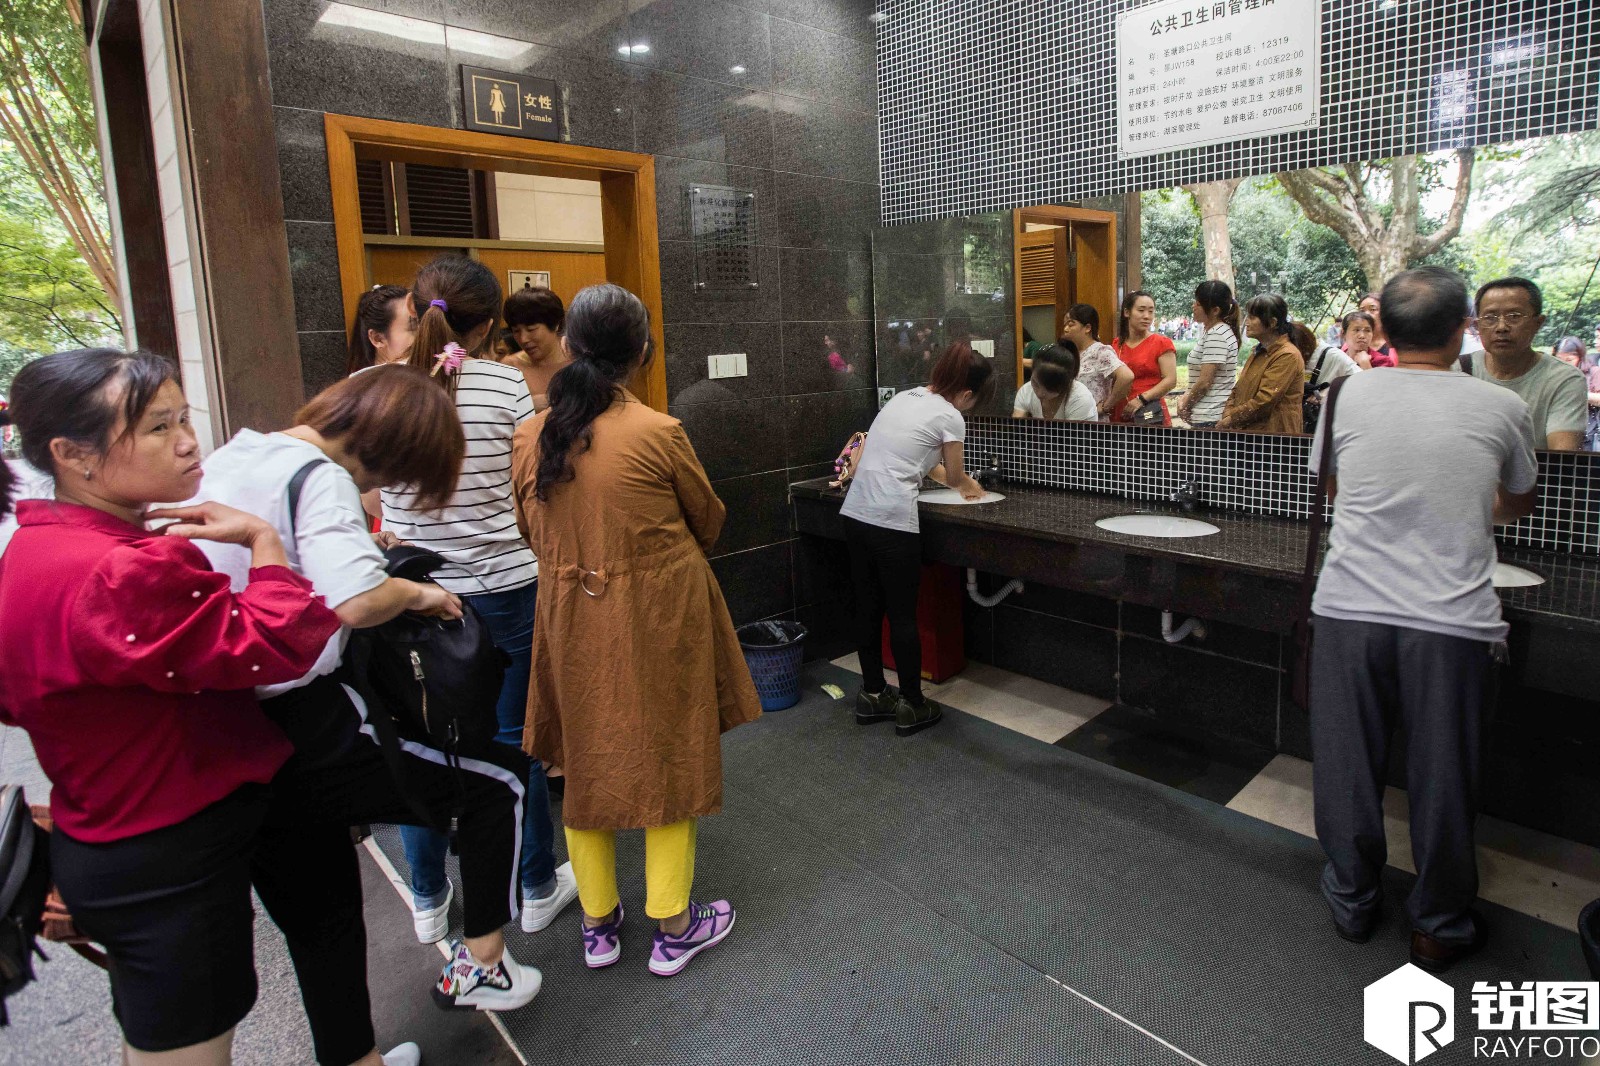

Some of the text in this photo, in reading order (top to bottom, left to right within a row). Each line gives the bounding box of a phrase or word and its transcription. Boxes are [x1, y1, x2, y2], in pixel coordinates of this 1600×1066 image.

[1261, 35, 1289, 49] 12319
[523, 93, 553, 110] 女性
[1262, 102, 1303, 117] 87087406
[526, 112, 553, 123] Female
